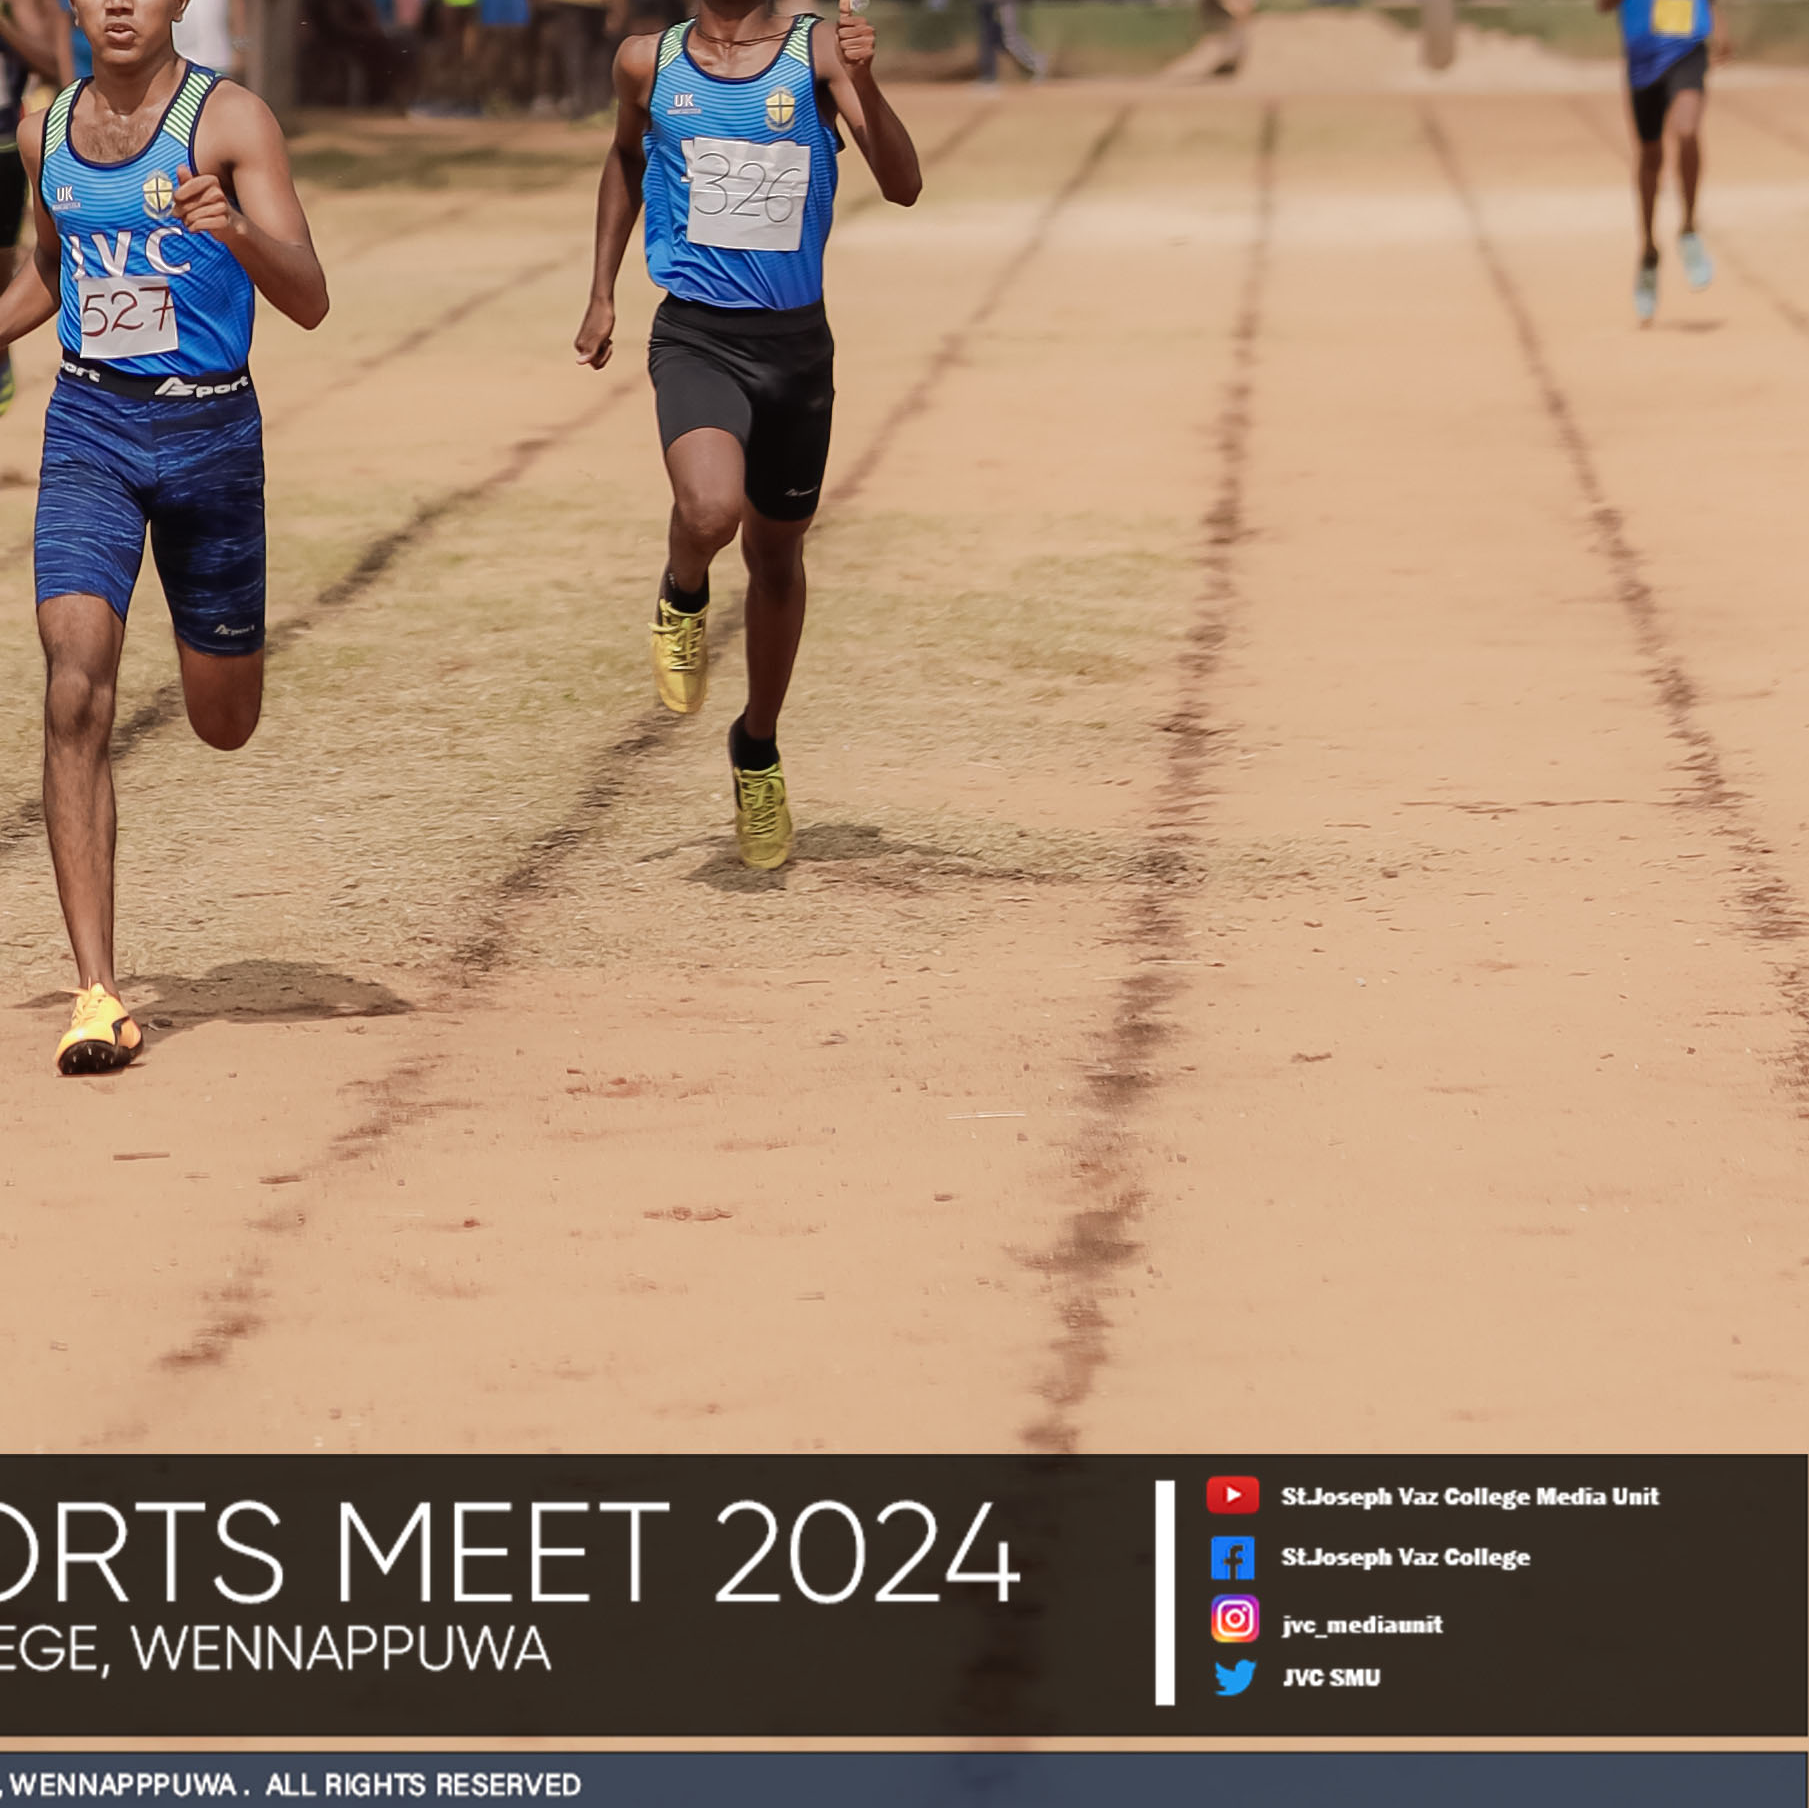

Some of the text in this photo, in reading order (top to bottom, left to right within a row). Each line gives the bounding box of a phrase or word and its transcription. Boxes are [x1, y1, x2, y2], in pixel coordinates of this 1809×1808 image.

[673, 93, 694, 108] UK
[56, 185, 73, 202] UK
[694, 152, 801, 223] 326
[81, 285, 175, 338] 527
